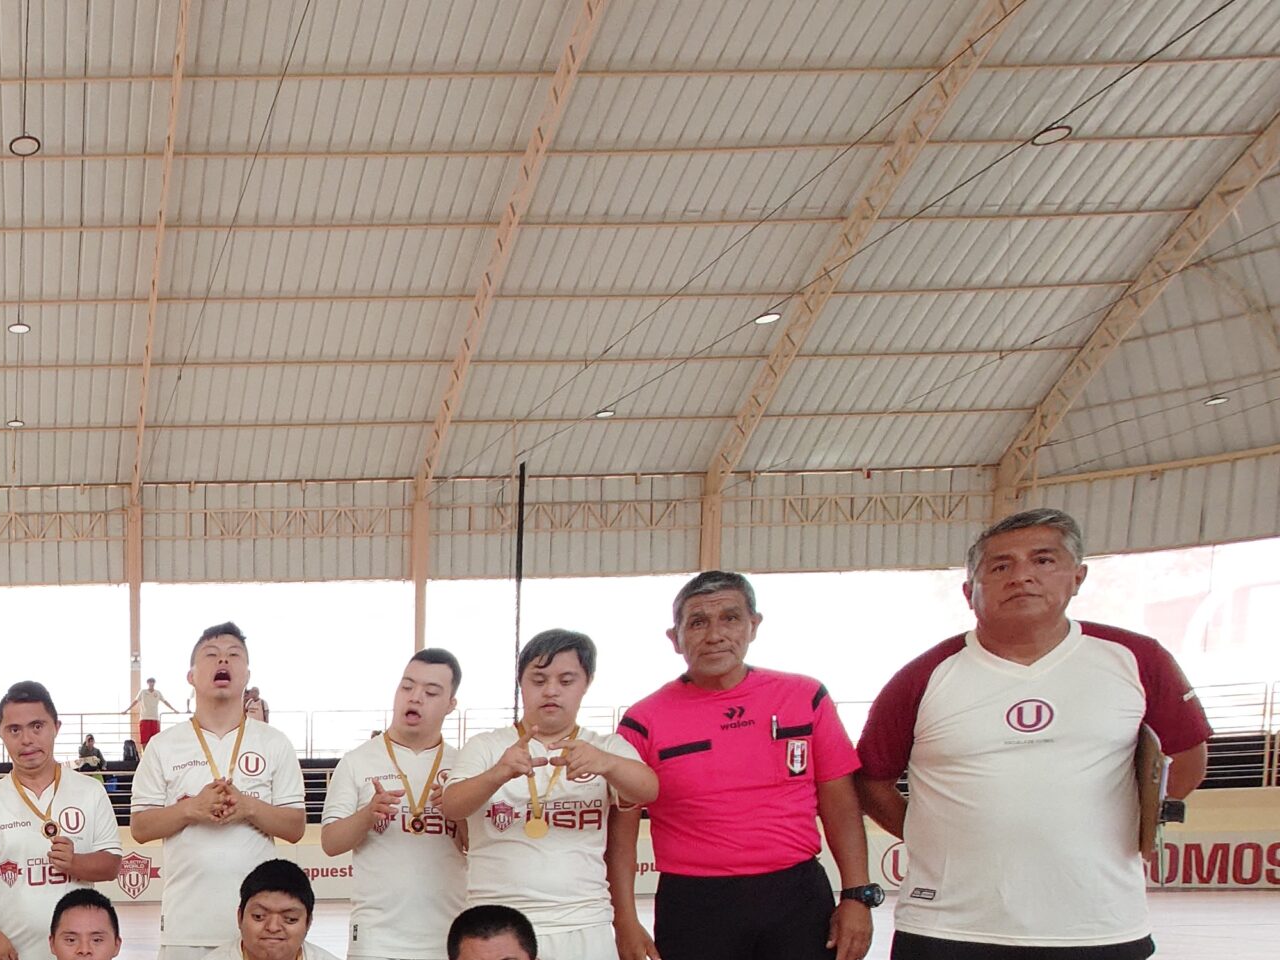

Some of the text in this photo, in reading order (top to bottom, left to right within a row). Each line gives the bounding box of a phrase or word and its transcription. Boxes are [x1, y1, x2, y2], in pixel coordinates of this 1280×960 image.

[720, 719, 756, 731] walon
[527, 799, 602, 810] CLECTIVO
[1143, 842, 1280, 885] OMOS
[27, 867, 71, 886] US
